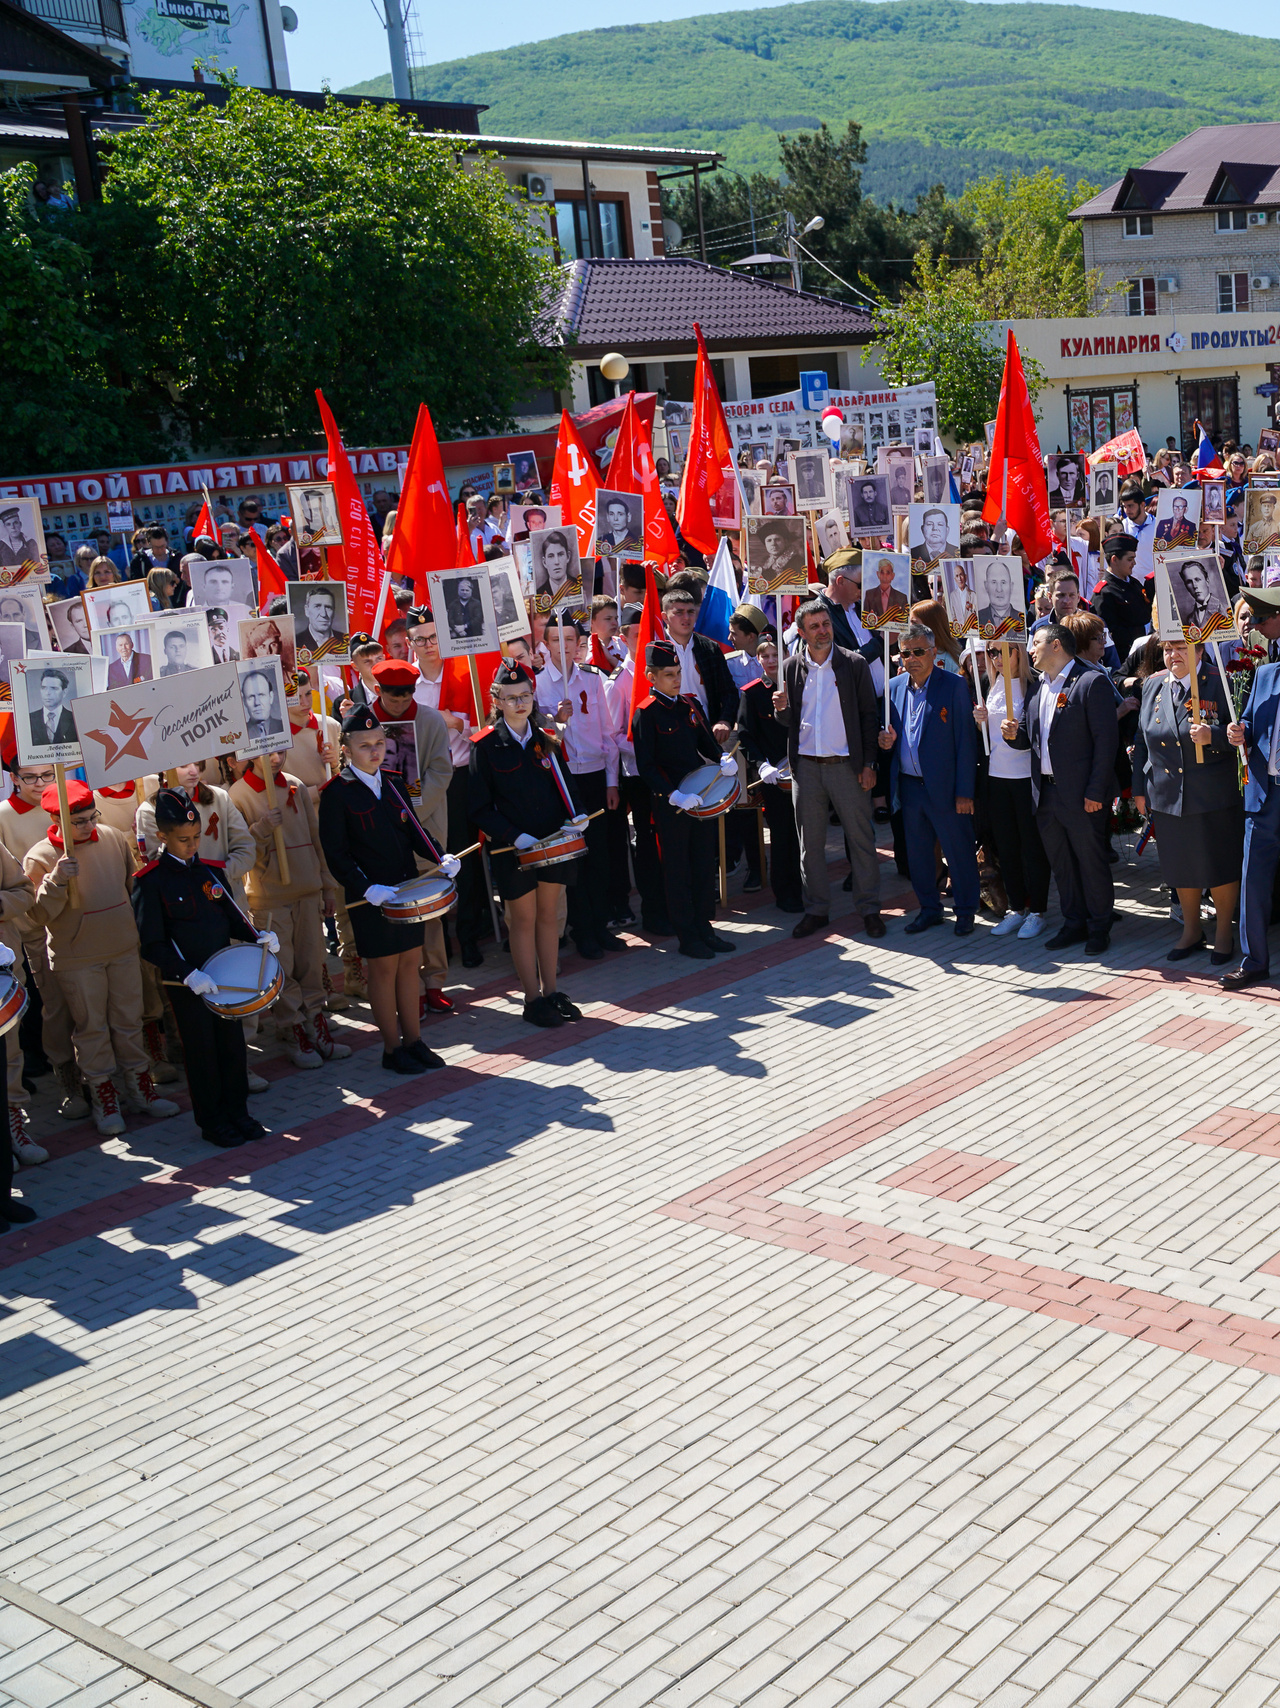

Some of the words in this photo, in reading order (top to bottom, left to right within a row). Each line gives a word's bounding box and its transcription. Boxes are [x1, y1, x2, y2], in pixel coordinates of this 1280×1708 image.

[1061, 334, 1160, 358] КУЛИНАРИЯ
[1191, 329, 1269, 350] ПРОДУКТЫ
[724, 402, 765, 417] СТОРИЯ
[769, 400, 795, 415] СЕЛА
[829, 392, 898, 407] КАБАРДИНКА
[137, 463, 283, 496] ПАМЯТИ
[287, 459, 311, 482] И
[474, 480, 495, 492] ОБЕДУ
[180, 709, 230, 748] ПОЛК
[27, 753, 55, 761] Николай
[47, 744, 73, 752] Лебедев
